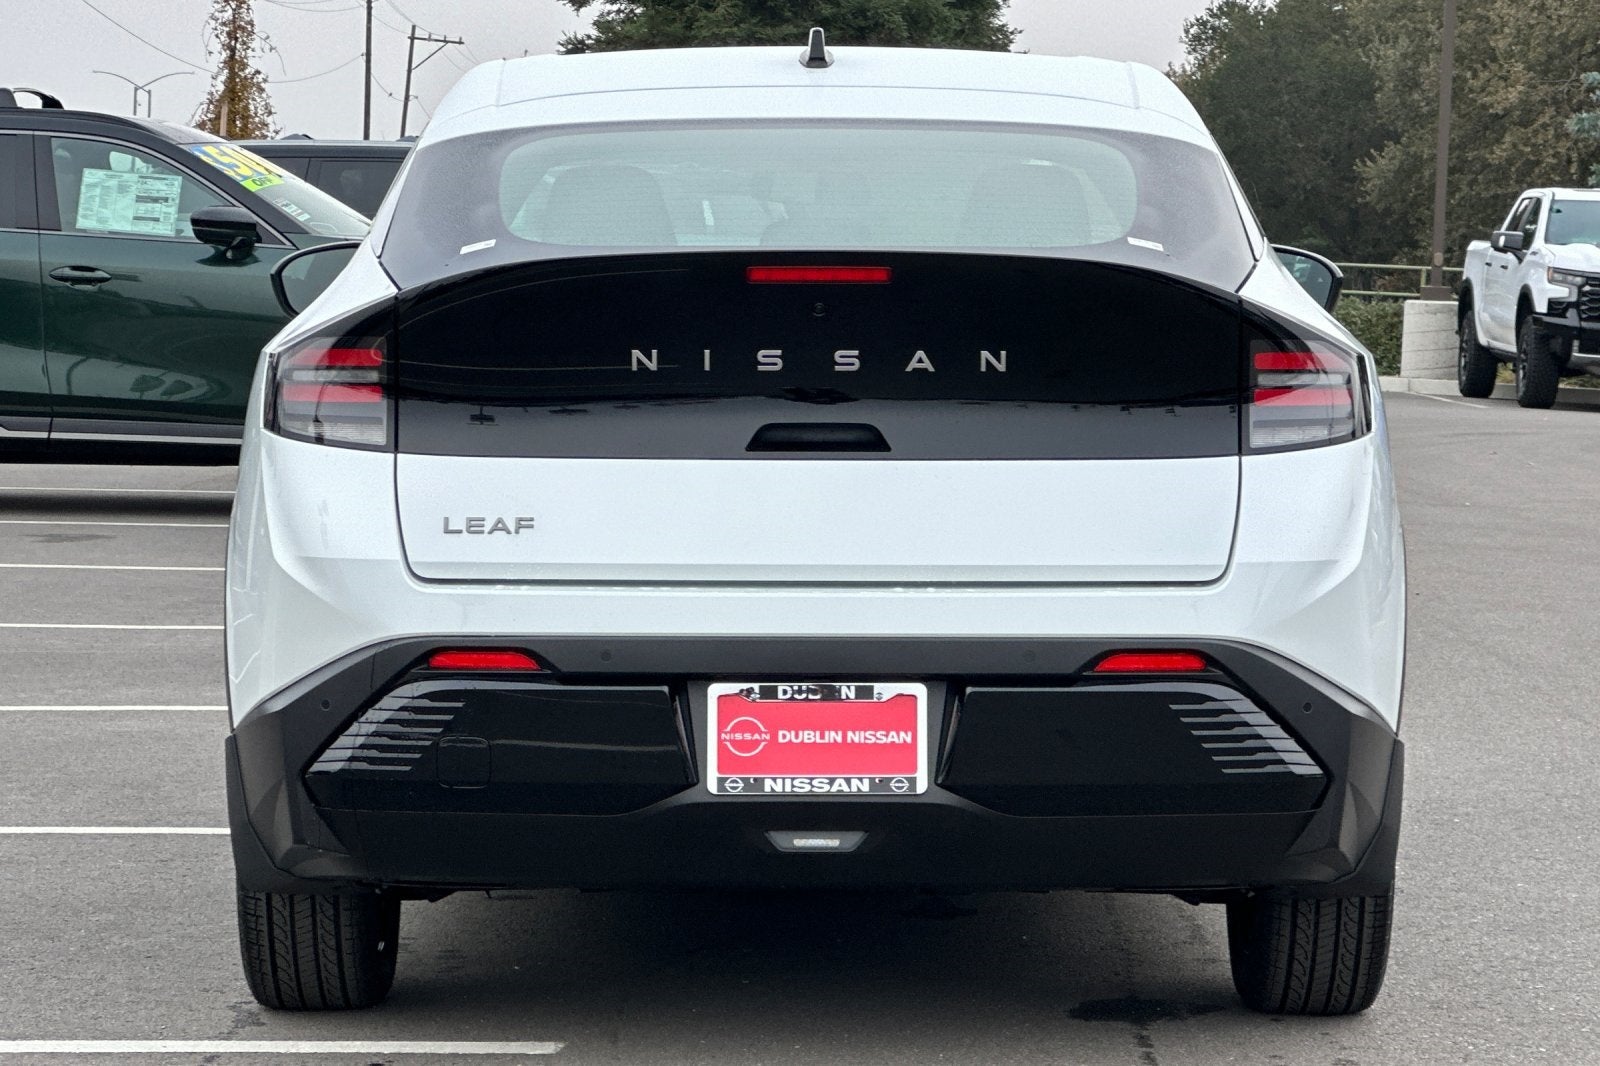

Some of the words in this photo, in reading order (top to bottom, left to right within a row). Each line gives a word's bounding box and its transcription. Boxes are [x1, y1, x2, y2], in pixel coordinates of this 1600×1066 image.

[631, 349, 1007, 372] NISSAN
[443, 516, 535, 535] LEAF
[720, 732, 770, 741] NISSAN
[777, 730, 842, 744] DUBLIN
[846, 730, 912, 744] NISSAN
[763, 778, 870, 793] NISSAN
